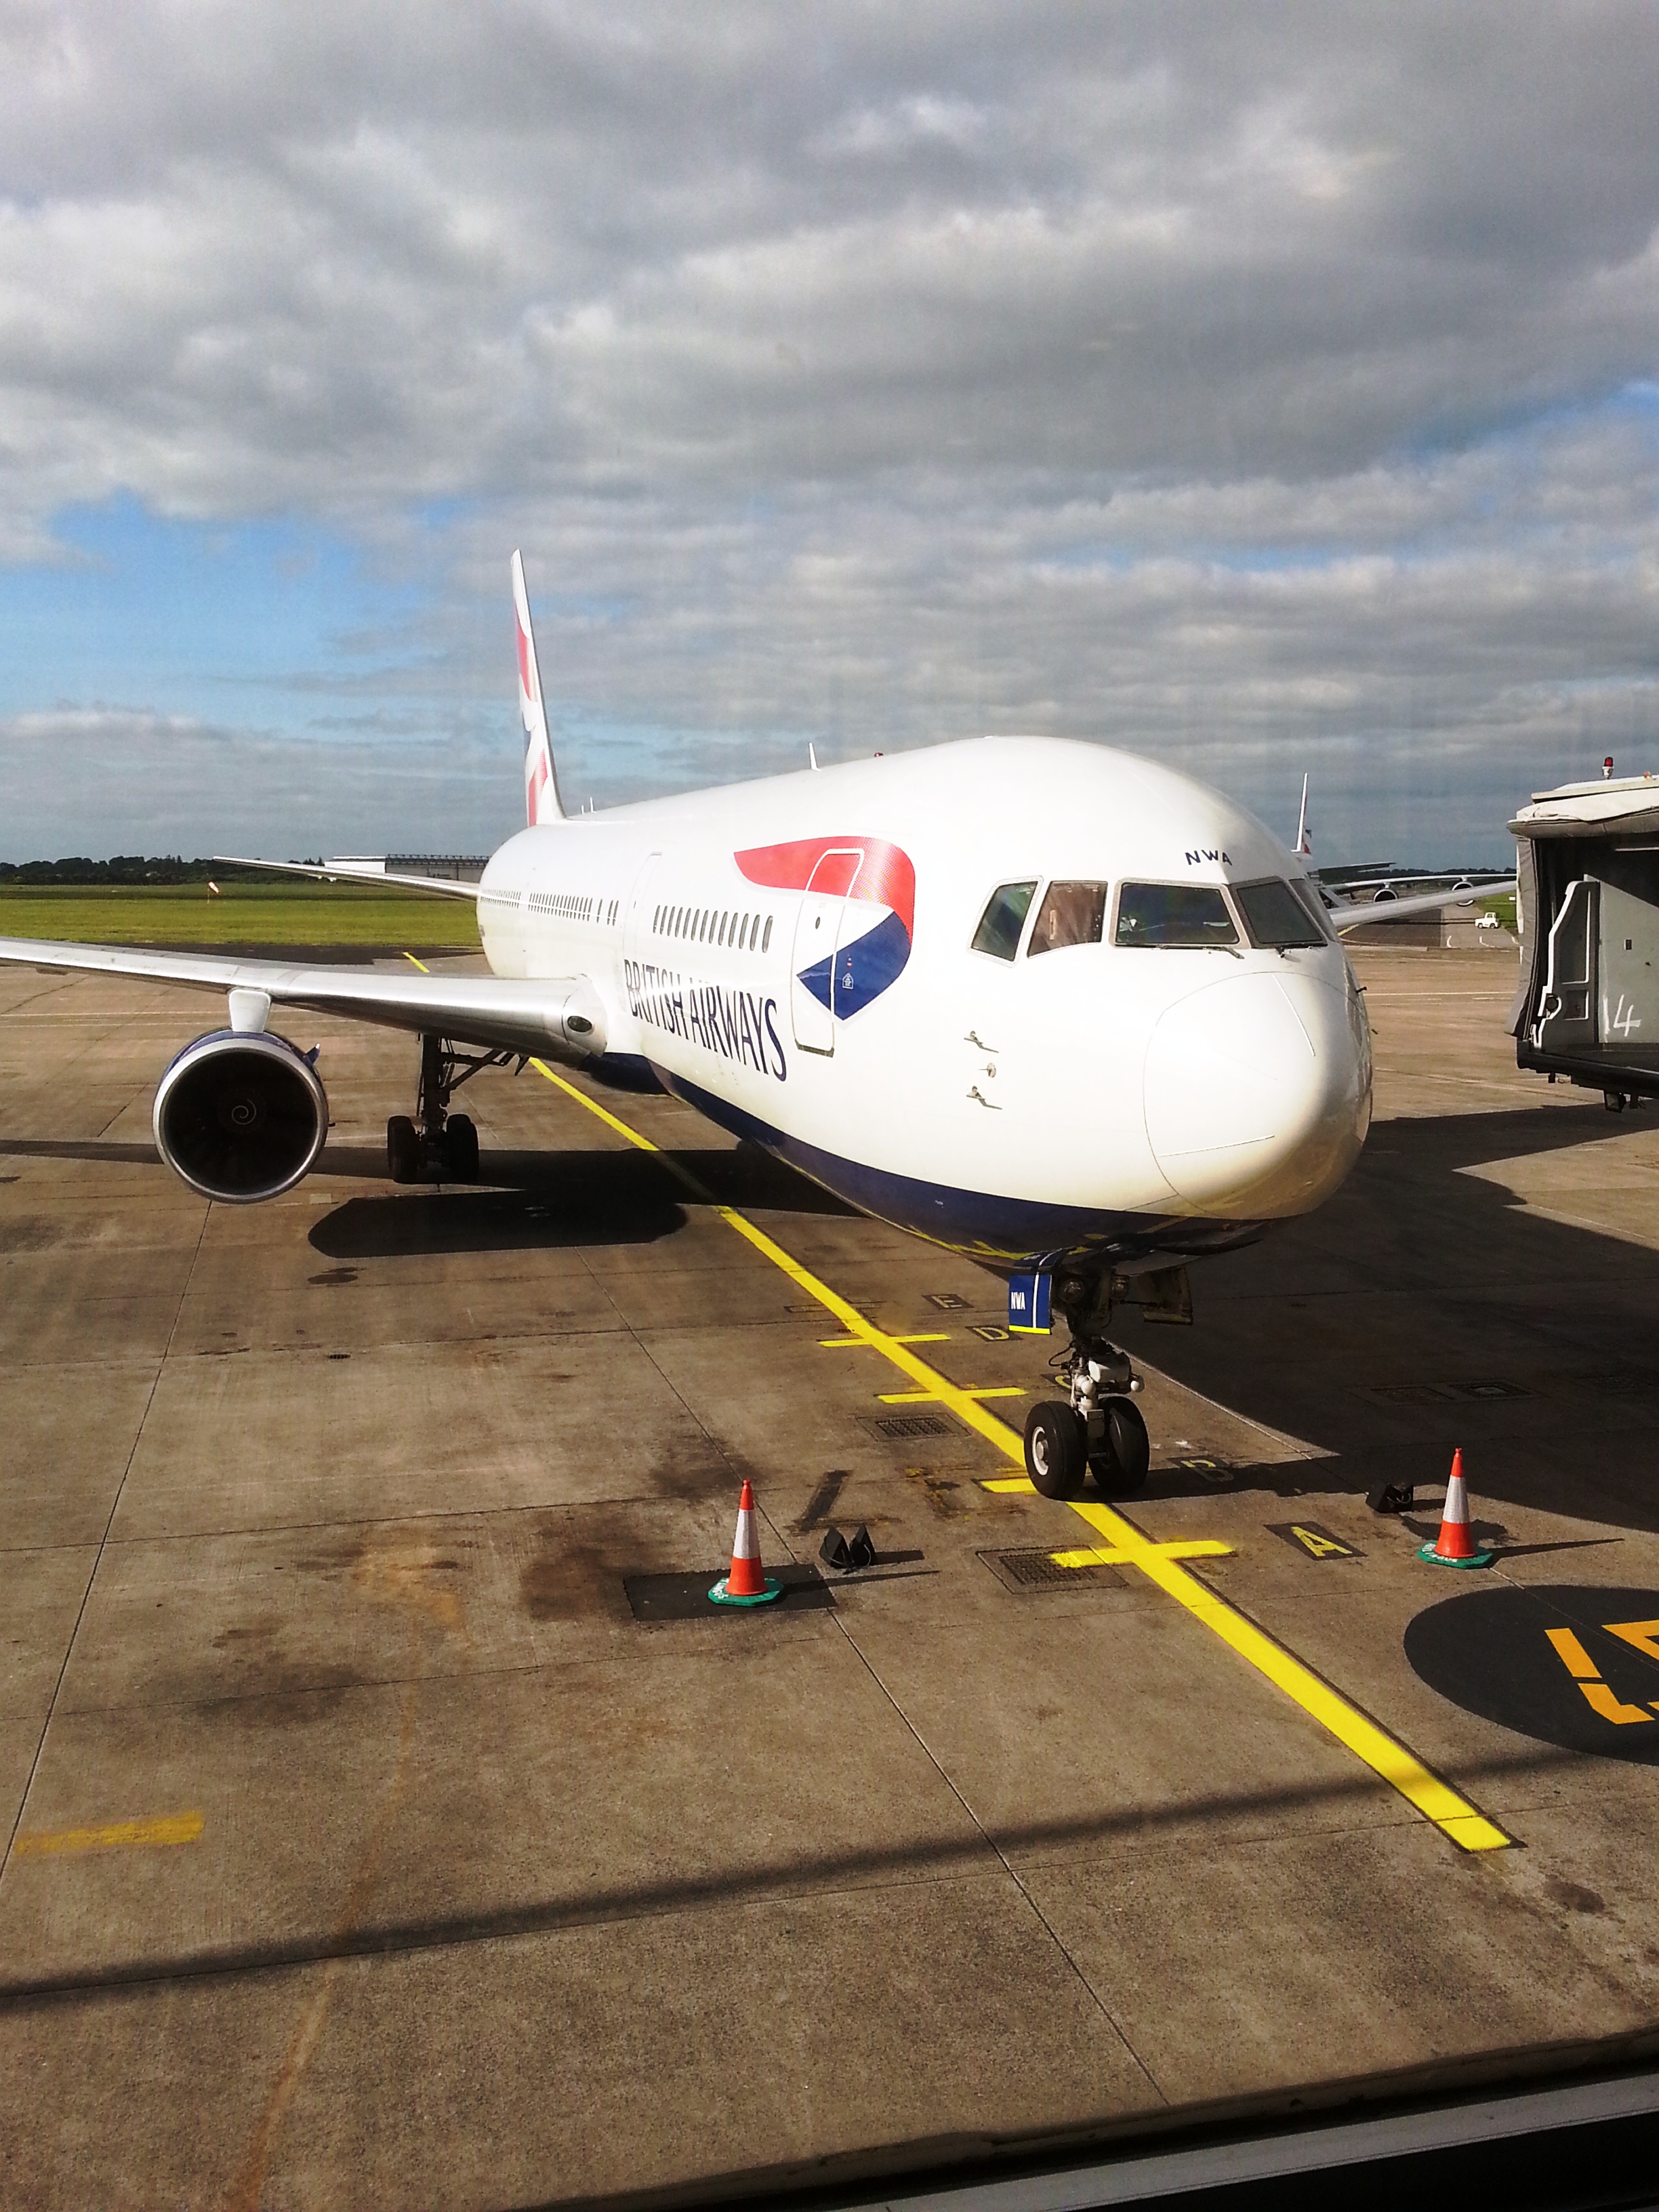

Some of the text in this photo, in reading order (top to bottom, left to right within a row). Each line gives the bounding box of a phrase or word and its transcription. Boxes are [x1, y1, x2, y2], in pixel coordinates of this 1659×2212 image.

[1185, 849, 1233, 866] NWA
[623, 958, 787, 1082] BRITISH AIRWAYS
[931, 1294, 963, 1308] E
[1010, 1291, 1026, 1310] NWA
[972, 1326, 1010, 1340] D
[1290, 1525, 1353, 1557] A
